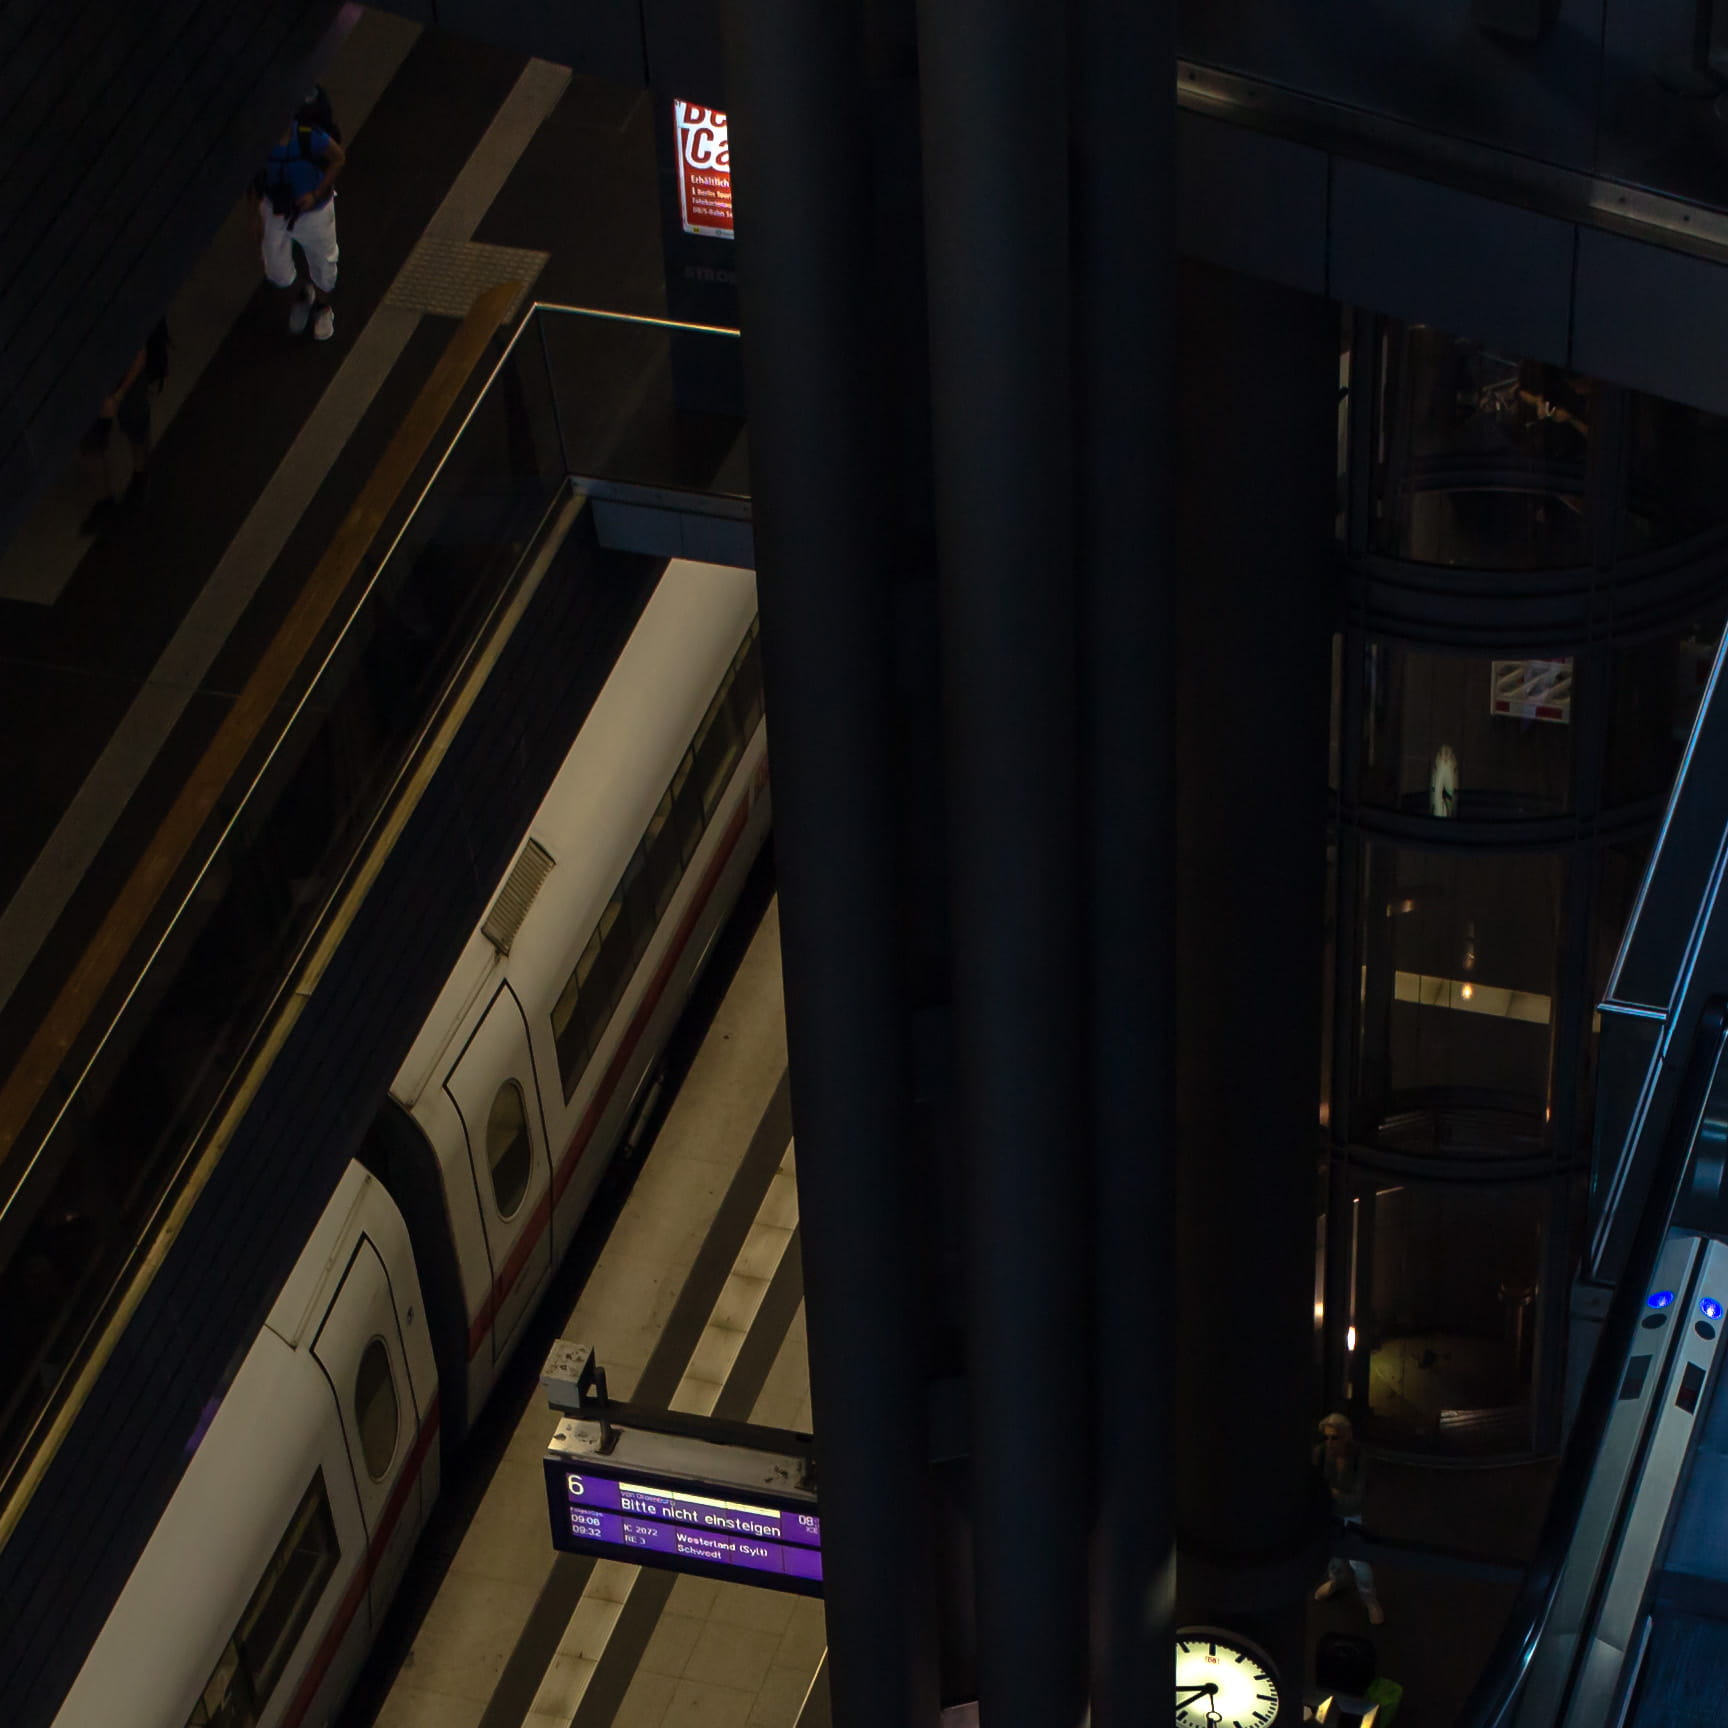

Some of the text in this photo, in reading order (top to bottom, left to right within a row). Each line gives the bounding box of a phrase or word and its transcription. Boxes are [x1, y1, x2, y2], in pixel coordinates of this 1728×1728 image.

[567, 1474, 585, 1496] 6
[621, 1497, 657, 1515] Bitte
[662, 1506, 698, 1523] nicht
[704, 1514, 781, 1537] einsteigen
[676, 1532, 736, 1551] Westerland
[739, 1544, 768, 1558] (Sylt)
[677, 1544, 722, 1559] Schwedt
